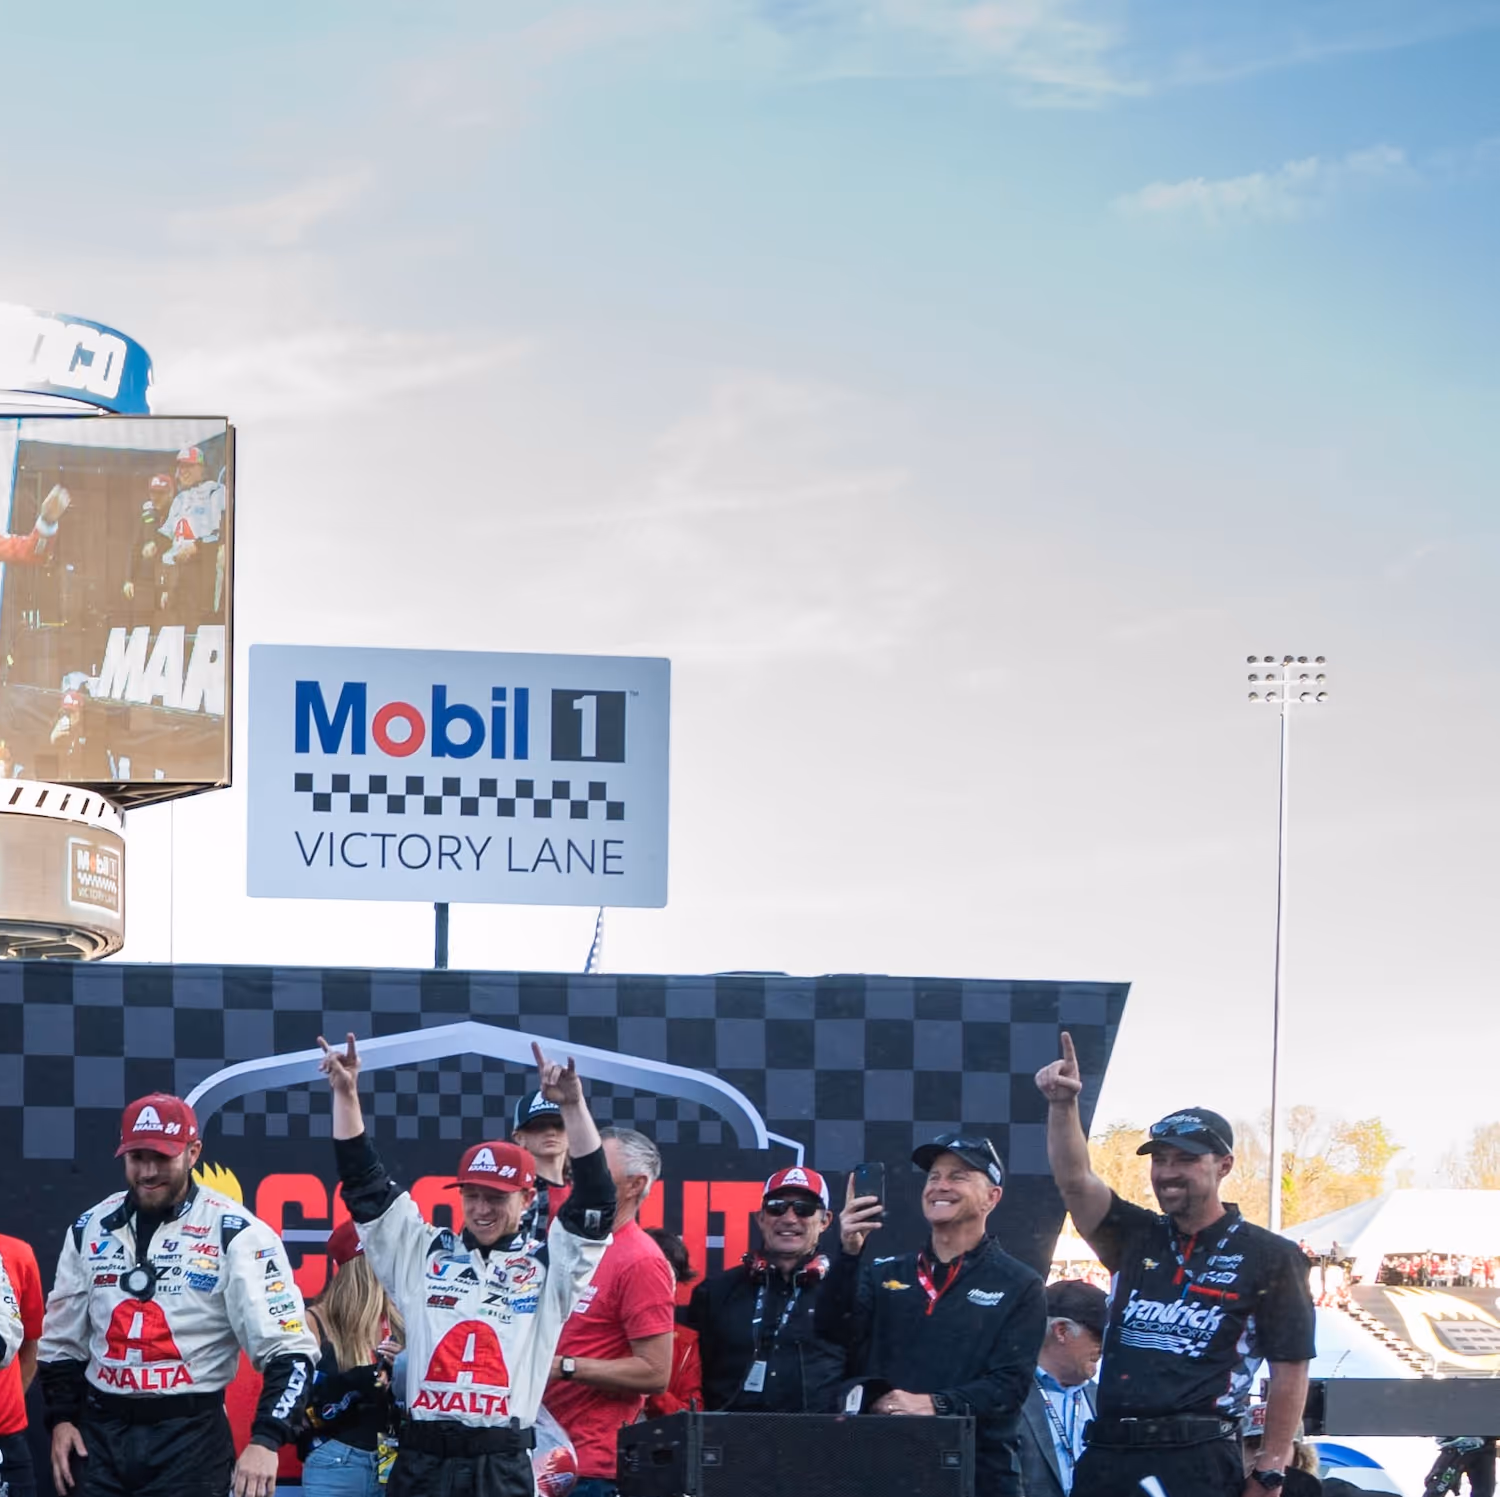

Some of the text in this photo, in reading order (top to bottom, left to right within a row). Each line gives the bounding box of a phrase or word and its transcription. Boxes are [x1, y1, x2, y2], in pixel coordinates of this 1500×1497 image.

[295, 680, 597, 760] Mobil 1
[295, 830, 625, 875] VICTORY LANE
[76, 849, 108, 874] Mobil
[132, 1122, 164, 1133] AXALTA
[164, 1121, 182, 1136] 24
[468, 1163, 499, 1173] AXALTA
[498, 1165, 517, 1179] 24
[162, 1238, 179, 1253] LU
[182, 1270, 220, 1284] Hendrick
[157, 1285, 182, 1293] RELAY
[967, 1288, 1006, 1302] Hendrick
[97, 1364, 194, 1391] AXALTA
[412, 1390, 510, 1417] AXALTA
